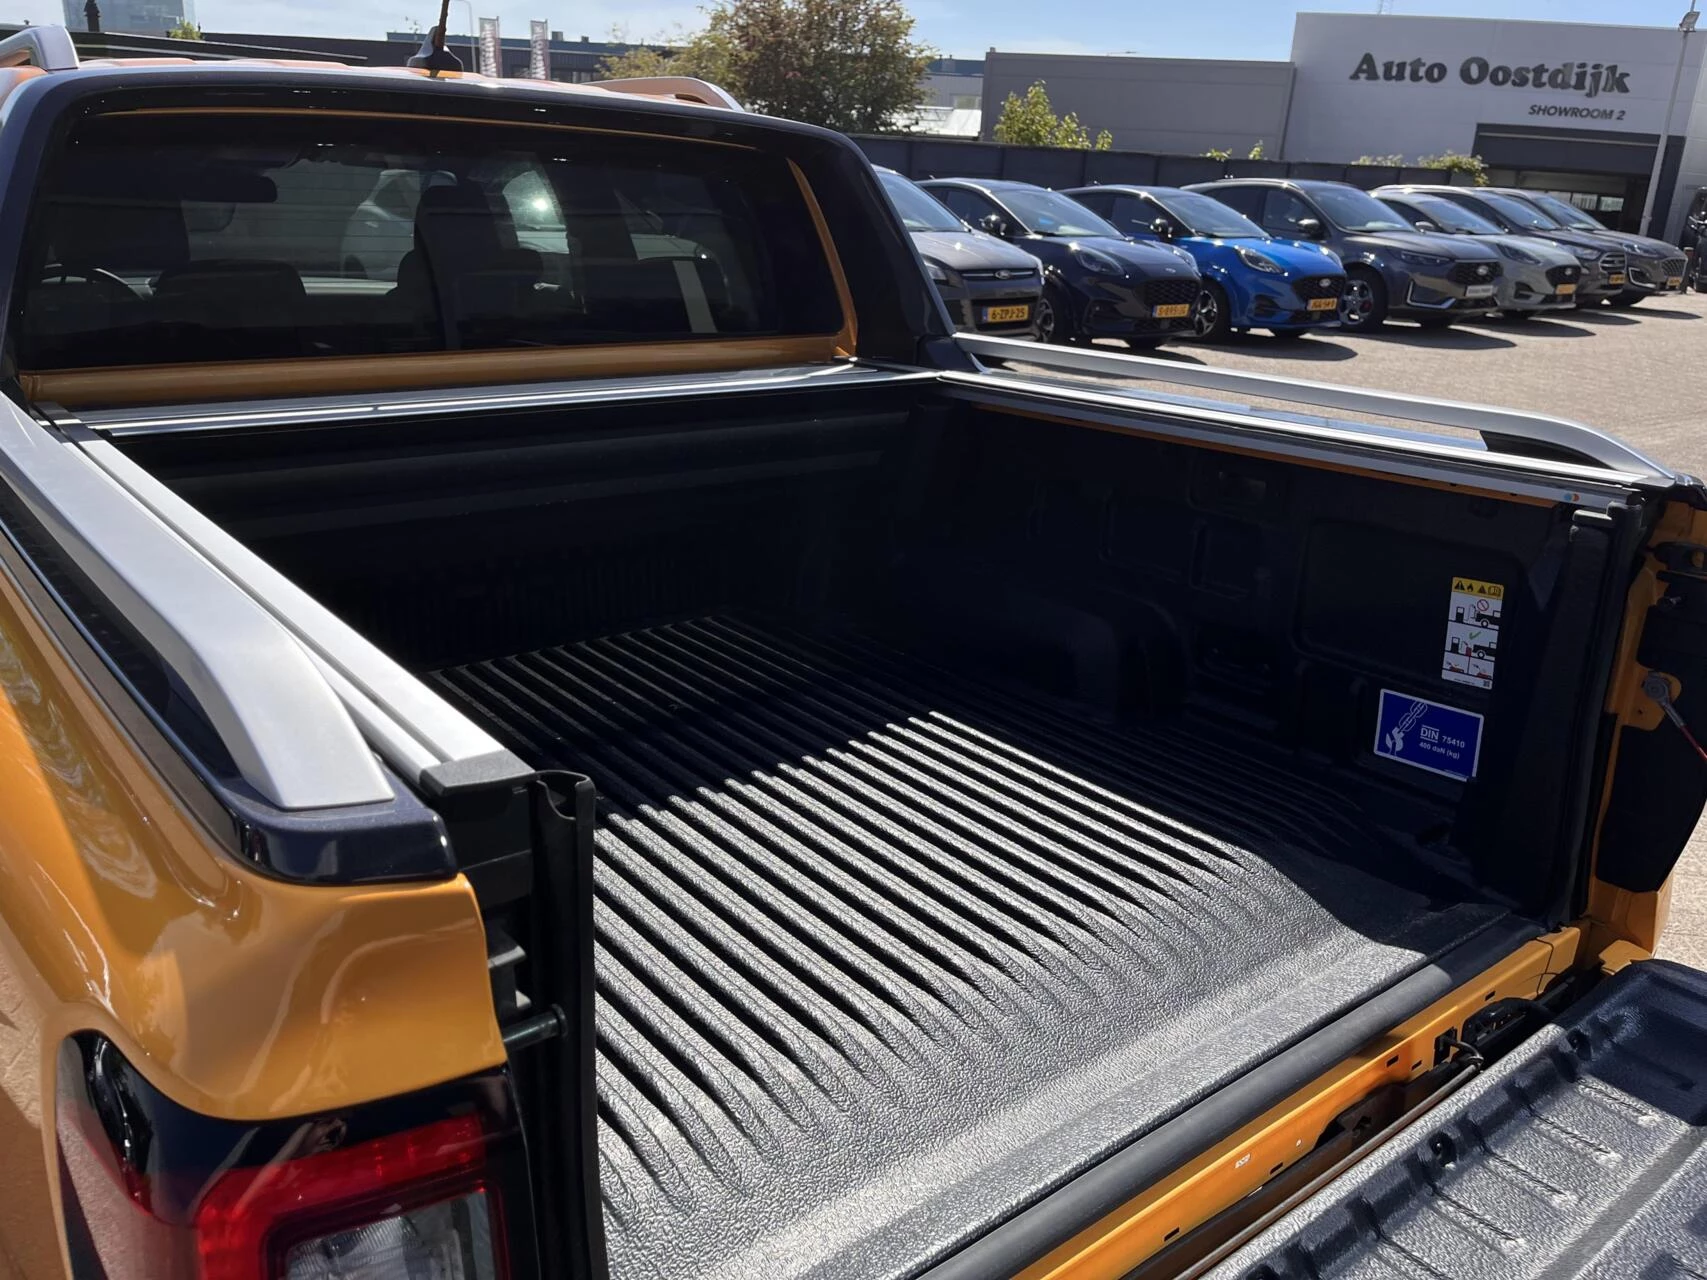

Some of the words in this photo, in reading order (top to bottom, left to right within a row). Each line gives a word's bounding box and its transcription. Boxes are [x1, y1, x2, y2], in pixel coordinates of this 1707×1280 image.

[1349, 52, 1447, 83] Auto
[1459, 56, 1630, 98] Oostdijk
[1528, 104, 1614, 121] SHOWROOM
[1616, 109, 1626, 121] 2
[1420, 726, 1440, 741] DIN
[1442, 735, 1465, 748] 75410
